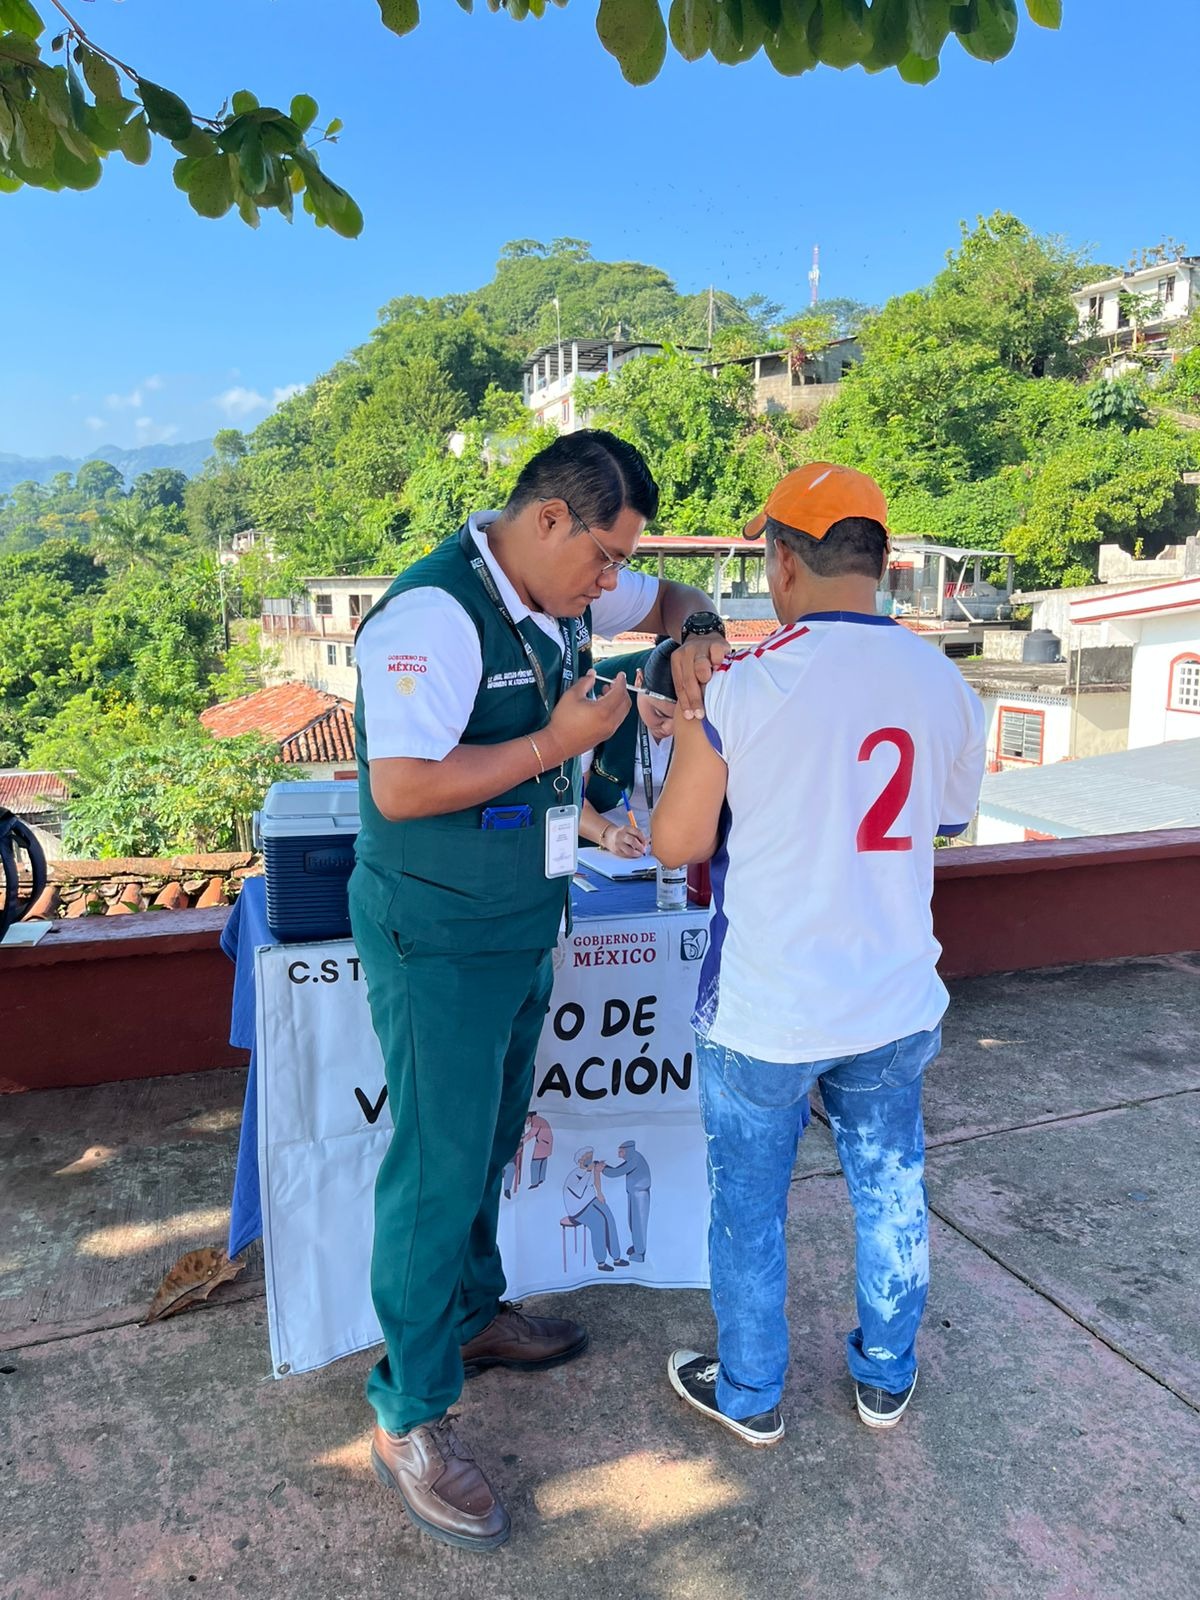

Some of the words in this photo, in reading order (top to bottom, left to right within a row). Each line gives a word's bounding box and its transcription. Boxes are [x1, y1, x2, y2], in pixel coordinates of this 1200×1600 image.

[388, 661, 428, 673] MÉXICO
[856, 727, 915, 853] 2
[573, 933, 639, 947] GOBIERNO
[641, 932, 657, 943] DE
[573, 946, 657, 968] MÉXICO
[346, 958, 367, 981] T
[601, 995, 657, 1037] DE
[533, 1042, 692, 1100] ACIÓN
